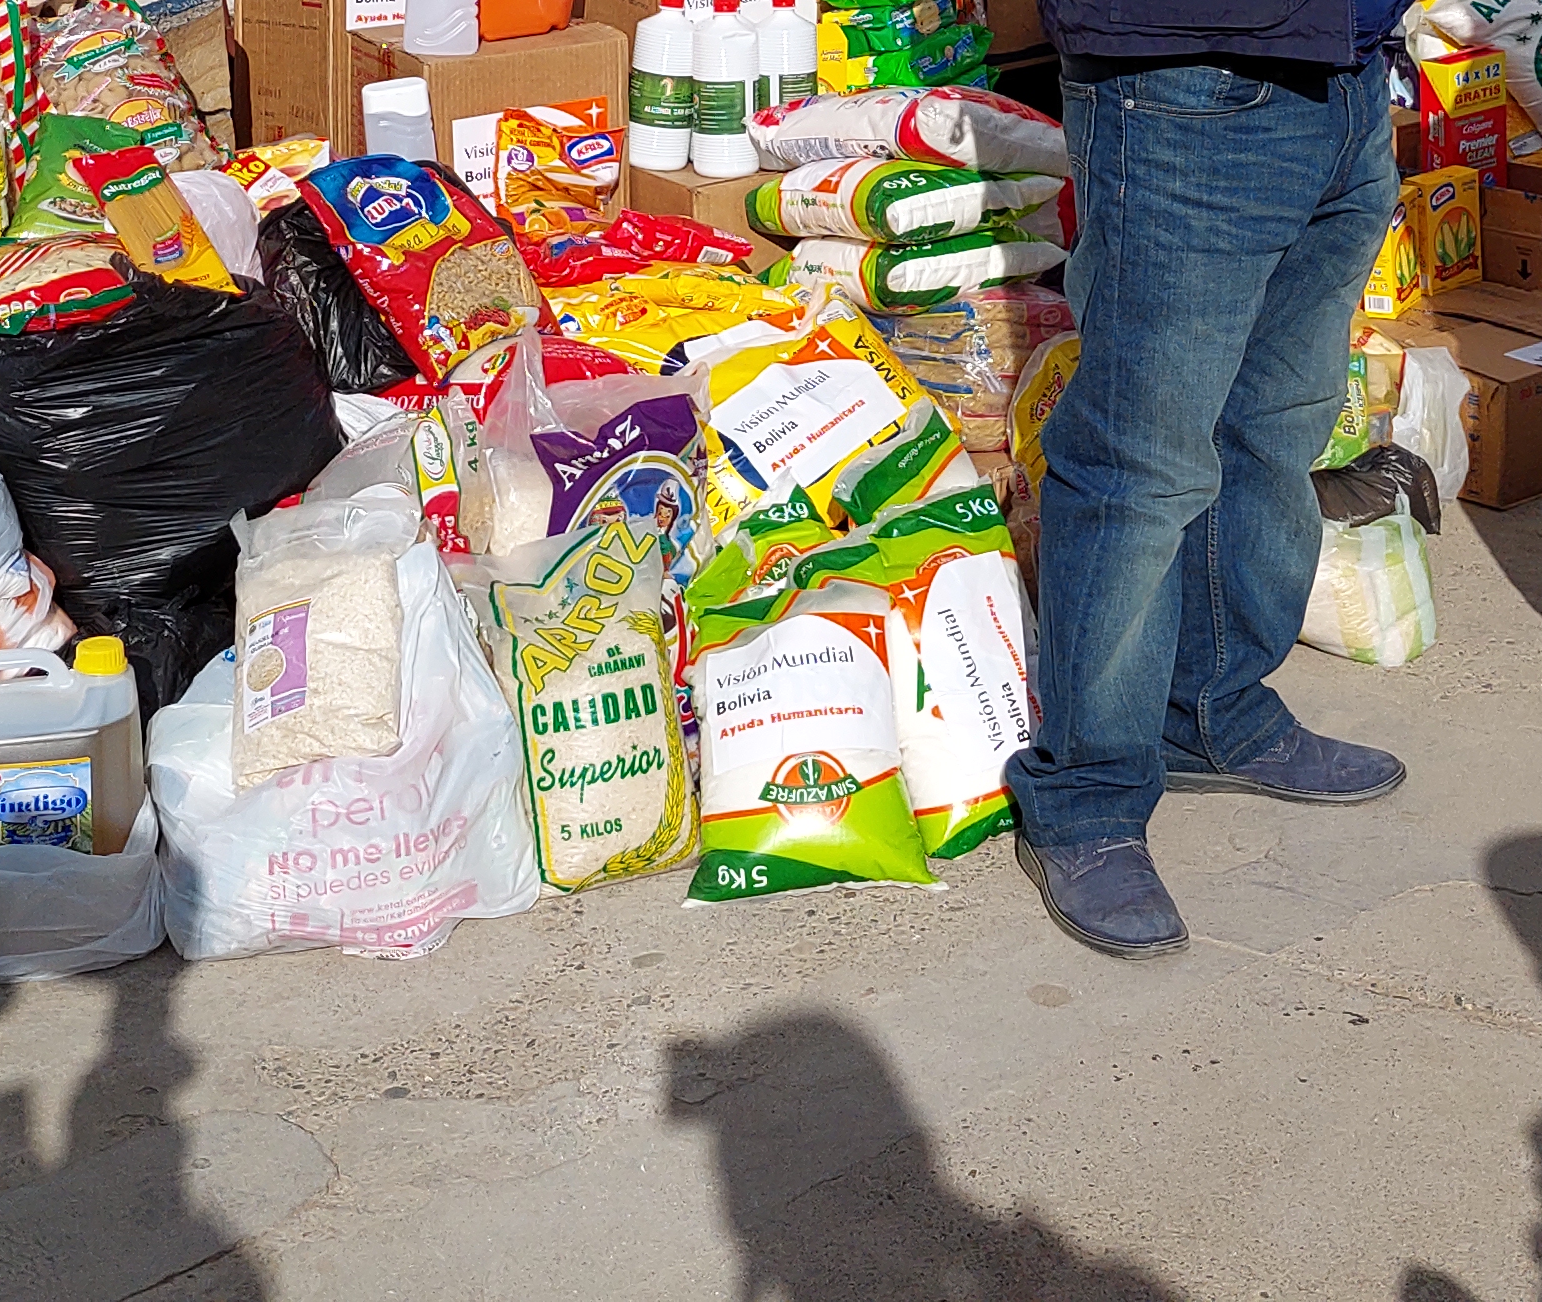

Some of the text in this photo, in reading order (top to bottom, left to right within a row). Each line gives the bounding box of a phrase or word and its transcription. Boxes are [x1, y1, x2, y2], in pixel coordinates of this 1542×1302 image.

[354, 13, 388, 24] Ayuda
[1454, 63, 1501, 88] 14 x 12
[464, 142, 495, 159] Visió
[577, 140, 604, 156] KRIS
[1458, 133, 1499, 154] Premier
[1467, 146, 1496, 163] CLEAN
[103, 169, 163, 199] Nutregal
[733, 369, 832, 434] Visión Mundial
[464, 419, 478, 448] kg
[752, 420, 799, 455] Bolivia
[769, 398, 866, 473] Ayuda Humanitaria
[955, 497, 999, 518] 5 Kg
[521, 520, 657, 696] ARROZ
[587, 652, 646, 678] CARANAVI
[606, 643, 622, 658] DE
[715, 645, 855, 689] Visión Mundial
[936, 608, 1006, 752] Visión Mundial
[531, 682, 658, 736] CALIDAD
[715, 686, 773, 716] Bolivia
[1001, 681, 1032, 743] Bolivia
[718, 704, 864, 740] Ayuda Humanitaria
[536, 742, 666, 803] Superior
[767, 778, 858, 802] SIN AZUFRE
[560, 817, 623, 841] 5 KILOS
[268, 848, 318, 876] NO
[330, 843, 382, 870] me
[269, 882, 287, 901] si
[295, 870, 391, 903] puedes
[718, 865, 769, 889] 5 Kg
